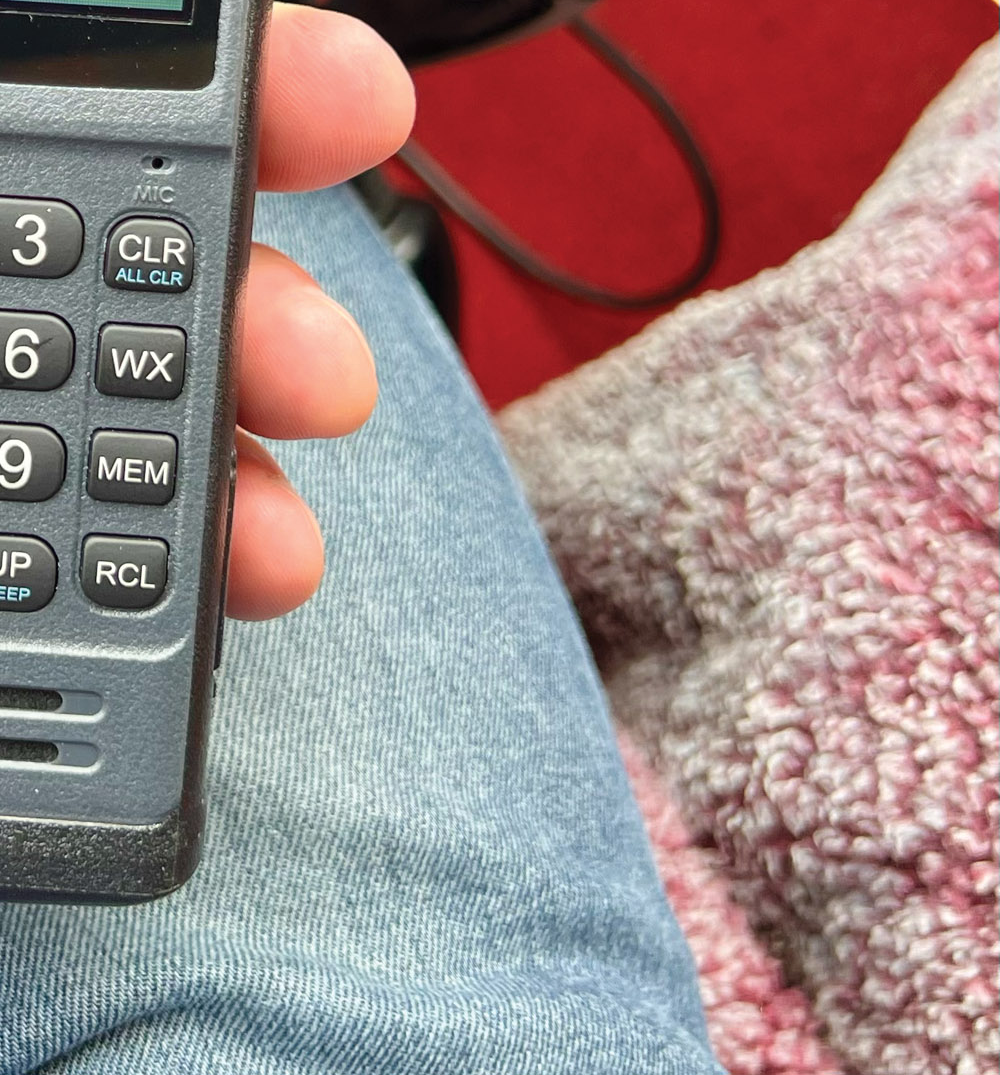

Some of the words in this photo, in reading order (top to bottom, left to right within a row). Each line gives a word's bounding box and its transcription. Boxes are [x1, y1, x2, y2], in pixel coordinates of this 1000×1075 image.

[134, 184, 175, 205] MIC
[11, 214, 47, 267] 3
[119, 234, 187, 265] CLR
[115, 268, 145, 285] ALL
[150, 269, 183, 287] CLR
[4, 328, 40, 379] 6
[112, 348, 173, 381] WX
[98, 456, 169, 486] MEM
[95, 562, 156, 590] RCL
